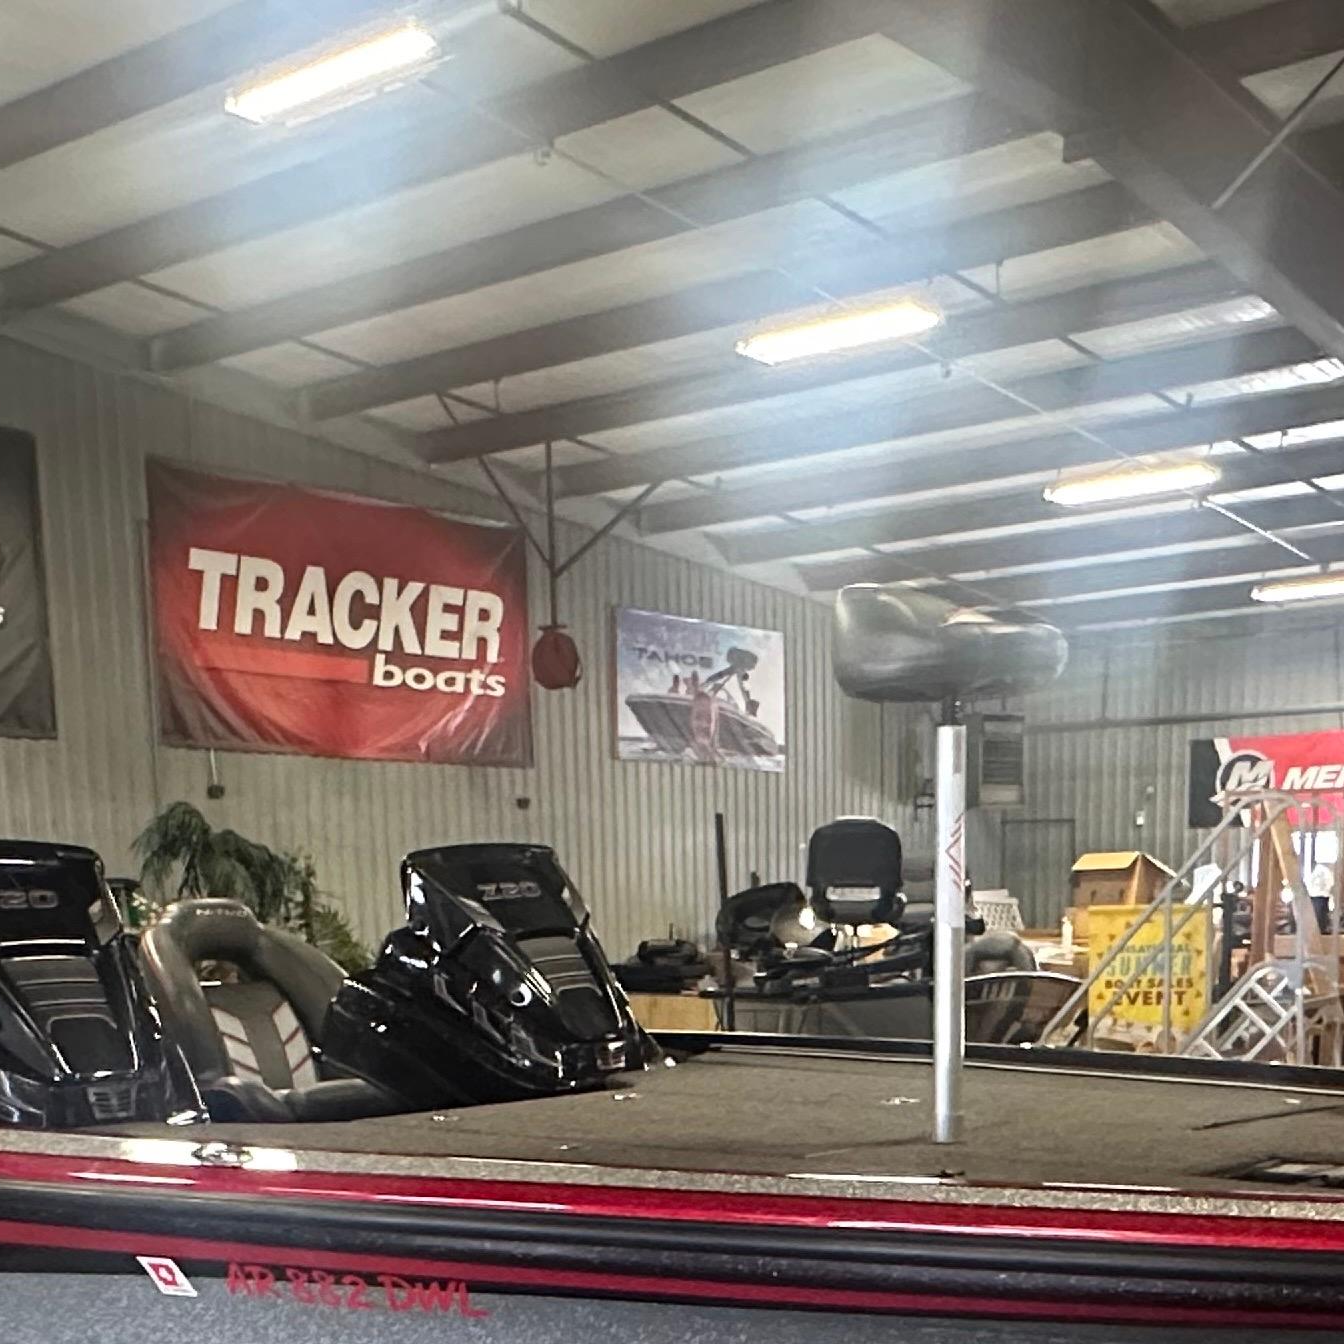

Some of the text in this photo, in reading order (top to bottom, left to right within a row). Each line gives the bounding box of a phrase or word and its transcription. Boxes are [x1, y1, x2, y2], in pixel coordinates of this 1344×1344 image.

[188, 548, 505, 663] TRACKER
[372, 654, 506, 697] boats
[225, 1262, 280, 1299] AR
[376, 1274, 489, 1319] DWL
